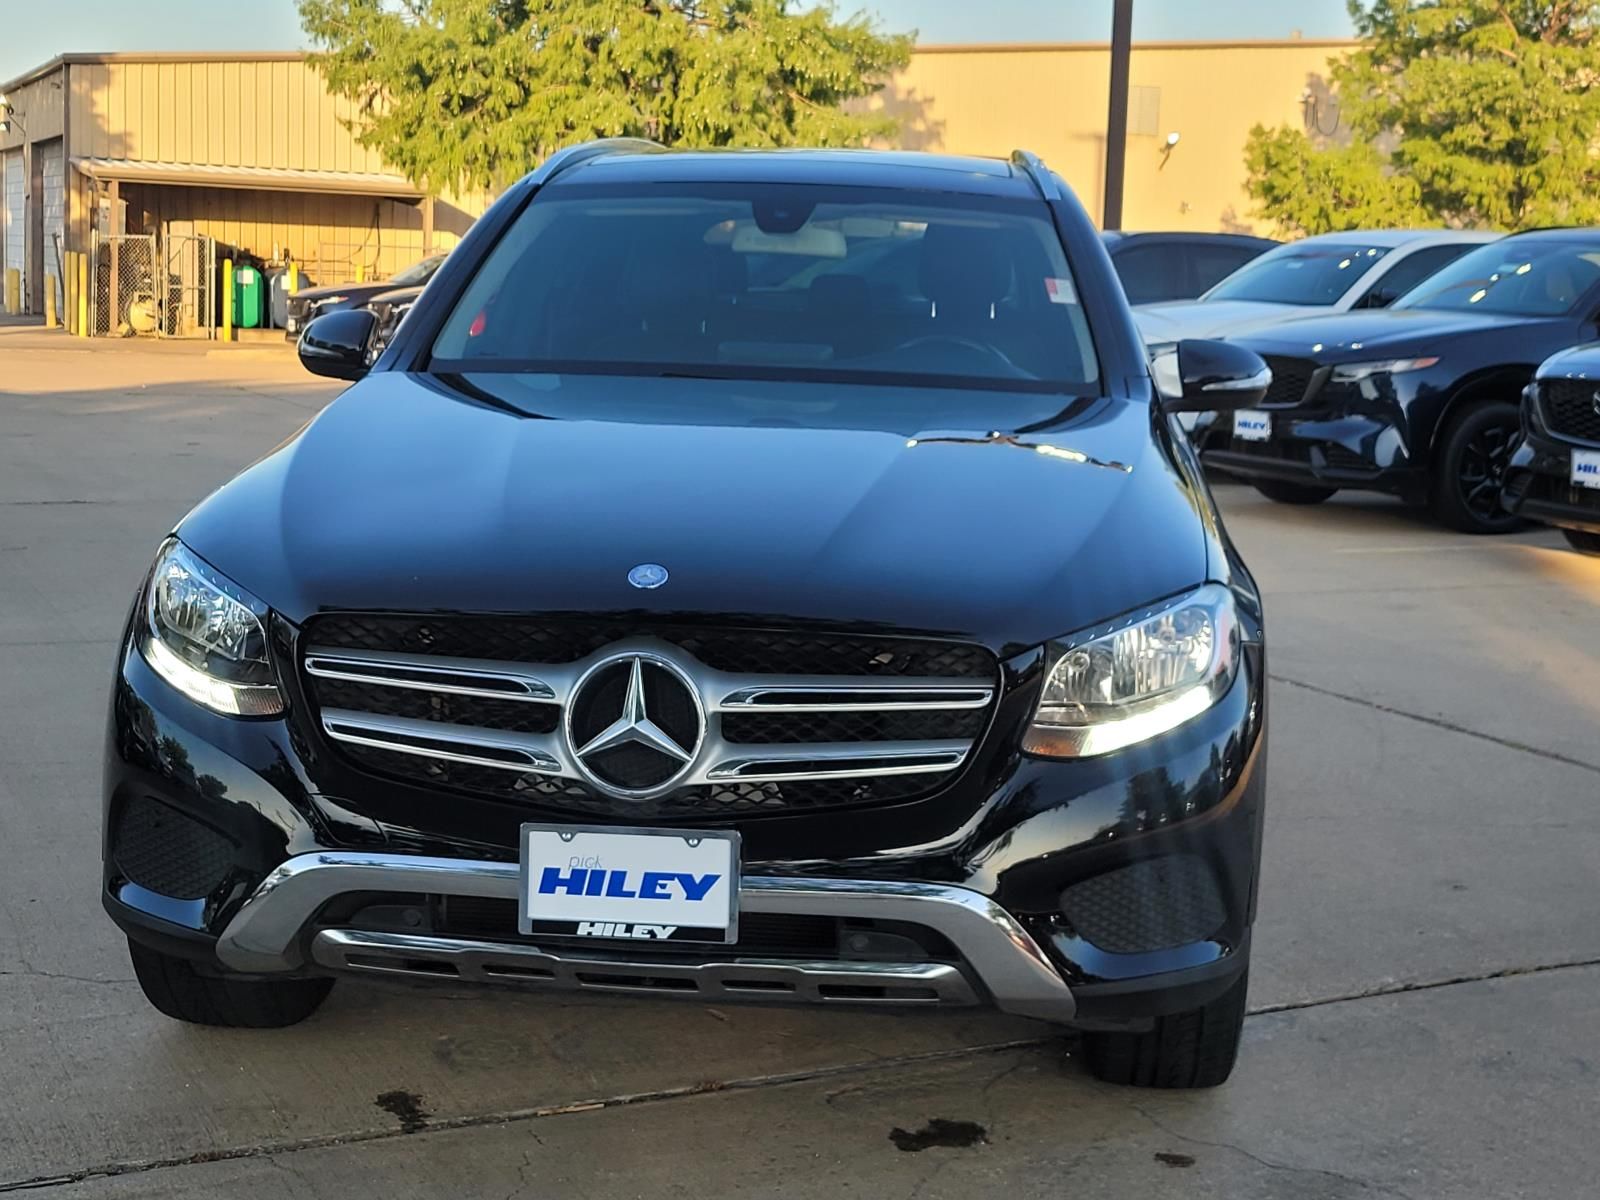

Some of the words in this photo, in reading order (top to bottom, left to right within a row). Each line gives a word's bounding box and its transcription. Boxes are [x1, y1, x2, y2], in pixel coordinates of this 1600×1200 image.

[568, 854, 602, 870] pick
[538, 867, 722, 901] HILEY
[576, 921, 678, 939] HILEY
